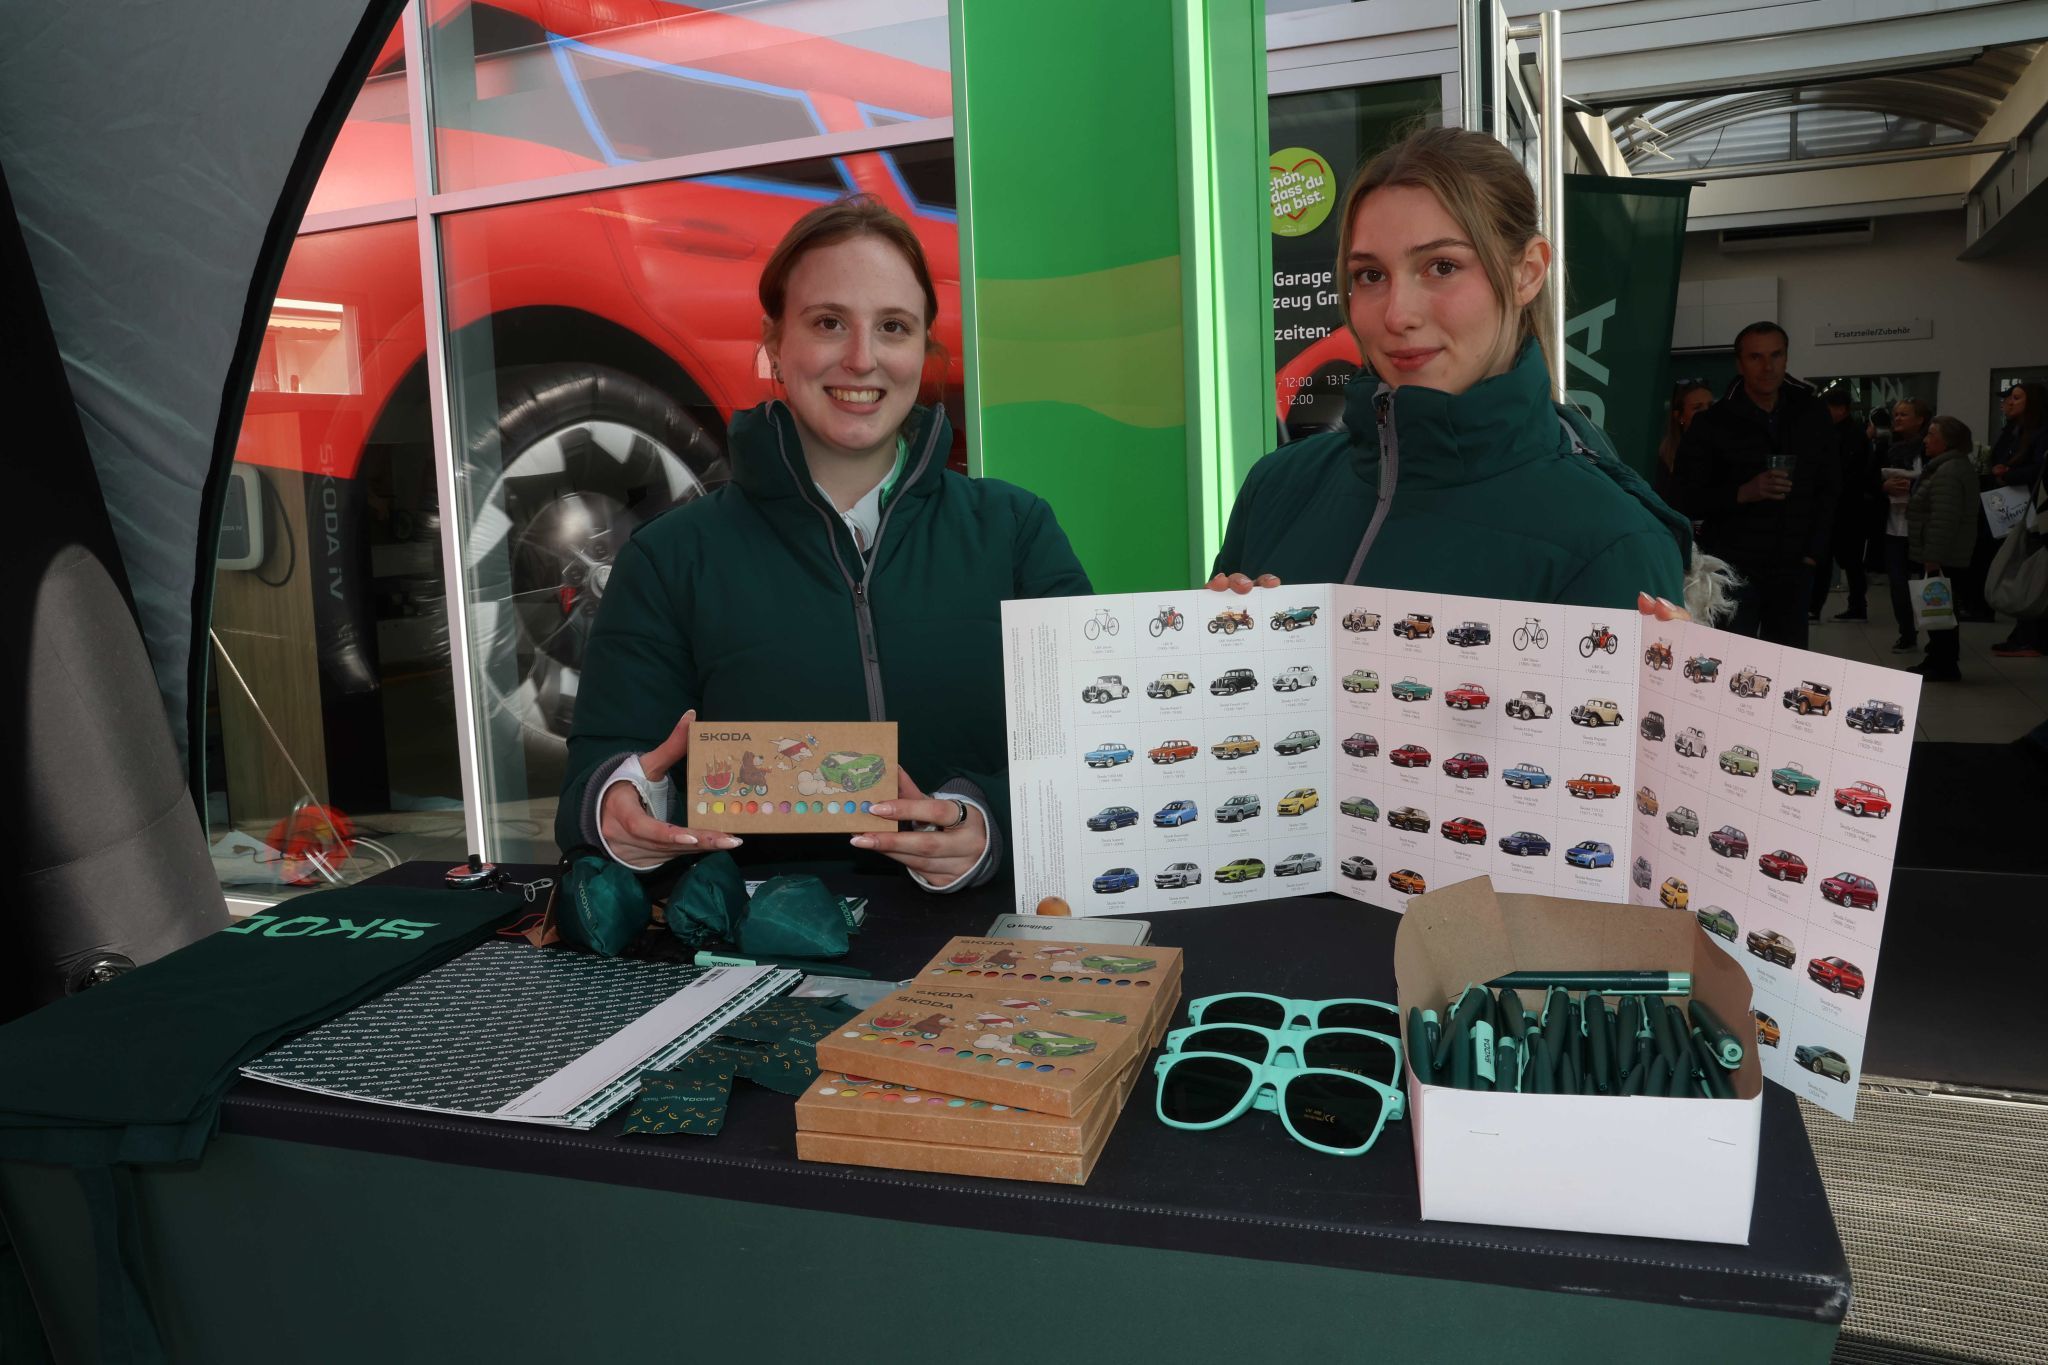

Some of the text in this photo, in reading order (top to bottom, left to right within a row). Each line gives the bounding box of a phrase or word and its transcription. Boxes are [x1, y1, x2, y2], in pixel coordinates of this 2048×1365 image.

[1271, 176, 1324, 204] dass du
[1274, 190, 1325, 216] da bist.
[1274, 272, 1332, 287] Garage
[1275, 324, 1330, 340] zeiten:
[1834, 326, 1911, 338] Ersatzteile/Zubehör
[1285, 374, 1350, 388] 12:00 13:15
[1286, 394, 1314, 405] 12:00
[320, 444, 344, 600] SKODA iV
[700, 732, 752, 742] SKODA
[578, 880, 592, 920] SKODA
[838, 900, 854, 926] SKODA
[222, 916, 440, 939] SKOD
[916, 990, 974, 999] SKODA
[896, 996, 954, 1010] SKODA
